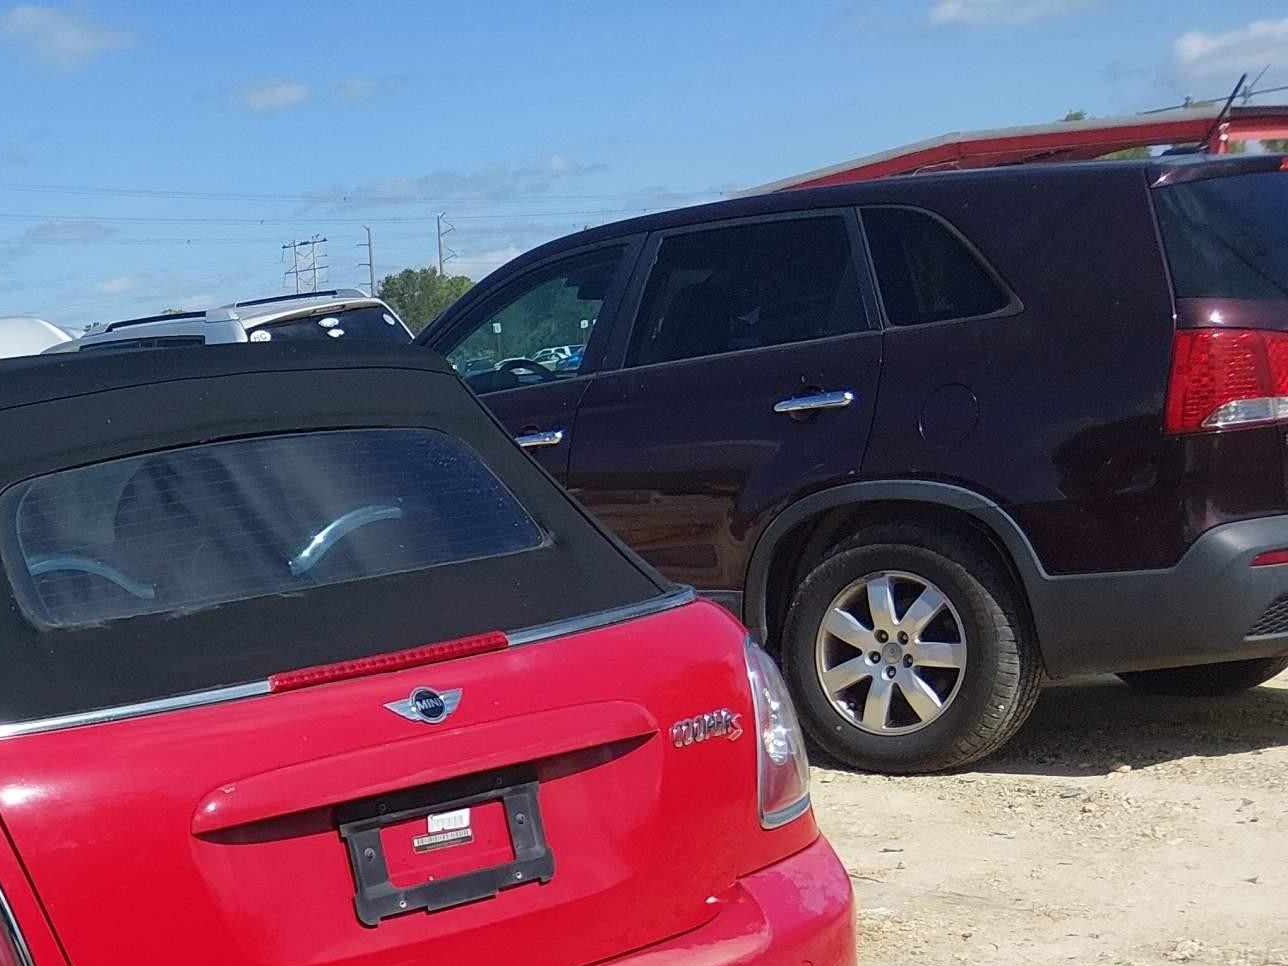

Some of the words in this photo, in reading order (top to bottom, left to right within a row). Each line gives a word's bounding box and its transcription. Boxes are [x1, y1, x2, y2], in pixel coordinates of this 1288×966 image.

[415, 697, 442, 711] MINI
[669, 708, 732, 748] COOPER
[727, 713, 744, 741] S
